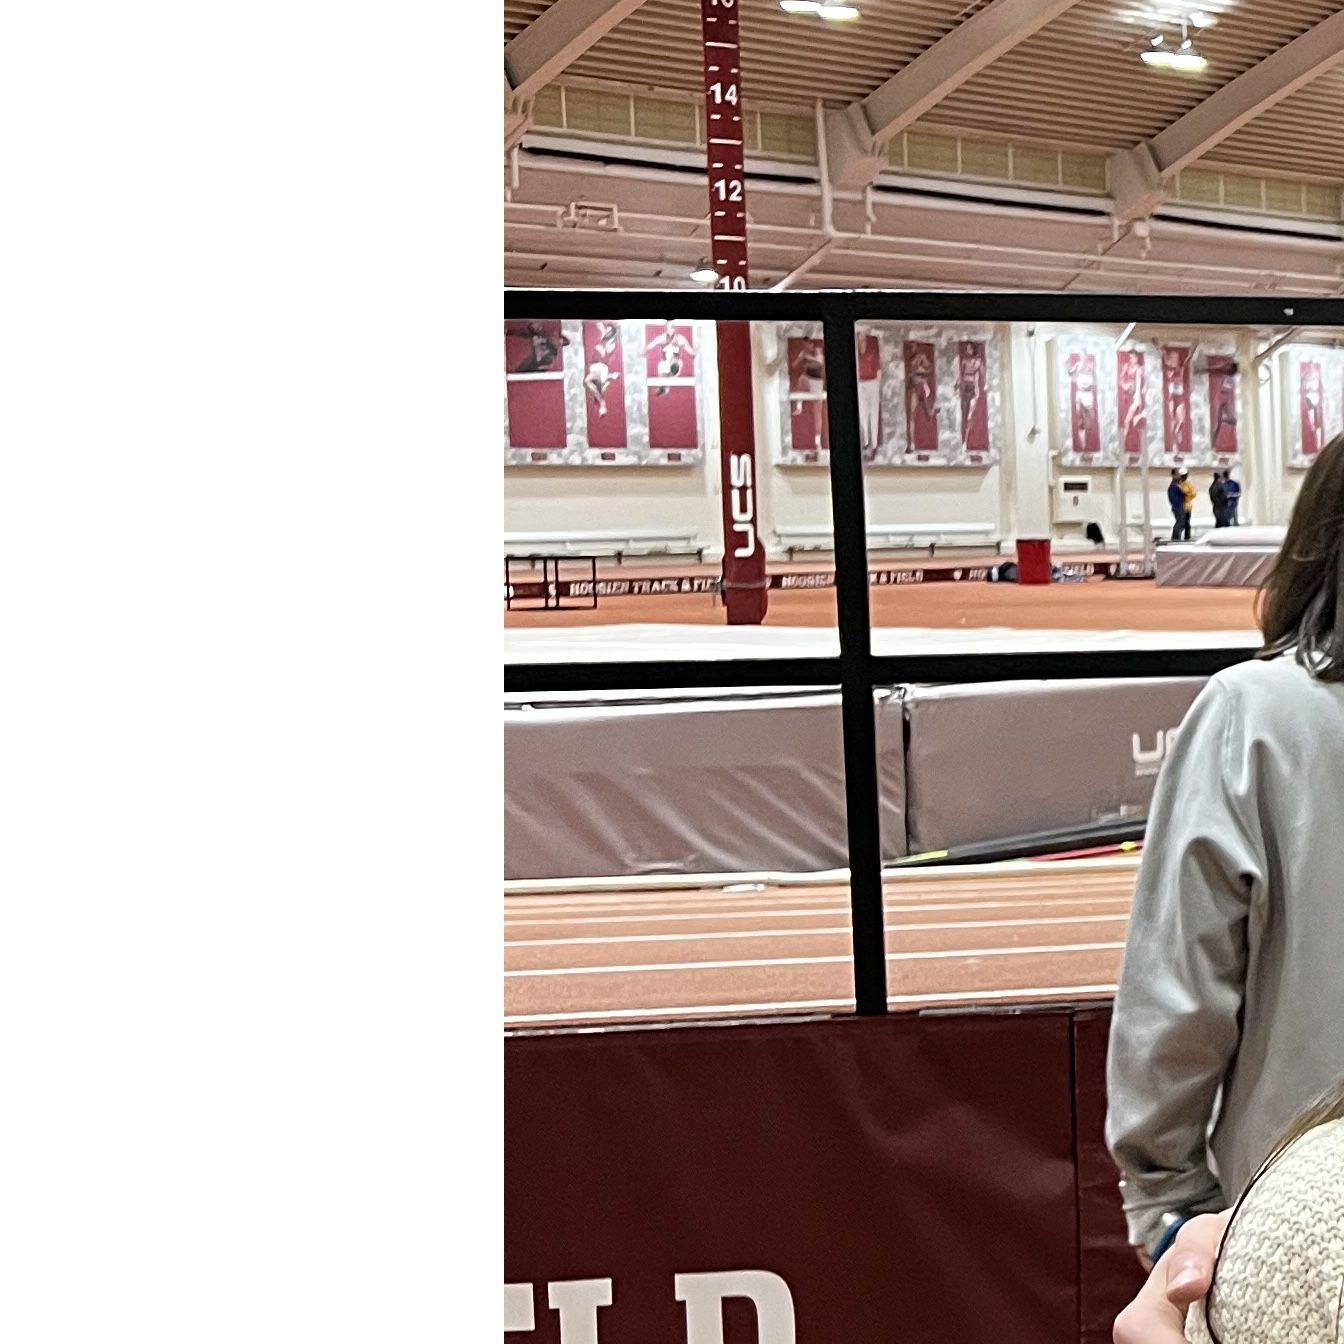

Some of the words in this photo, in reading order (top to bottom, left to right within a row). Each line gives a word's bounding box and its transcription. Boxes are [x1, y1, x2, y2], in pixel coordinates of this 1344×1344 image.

[709, 81, 738, 106] 14
[714, 179, 743, 202] 12
[718, 275, 747, 291] 10
[730, 453, 756, 558] UCS
[569, 579, 630, 597] HOOSIER
[632, 579, 679, 595] TRACK
